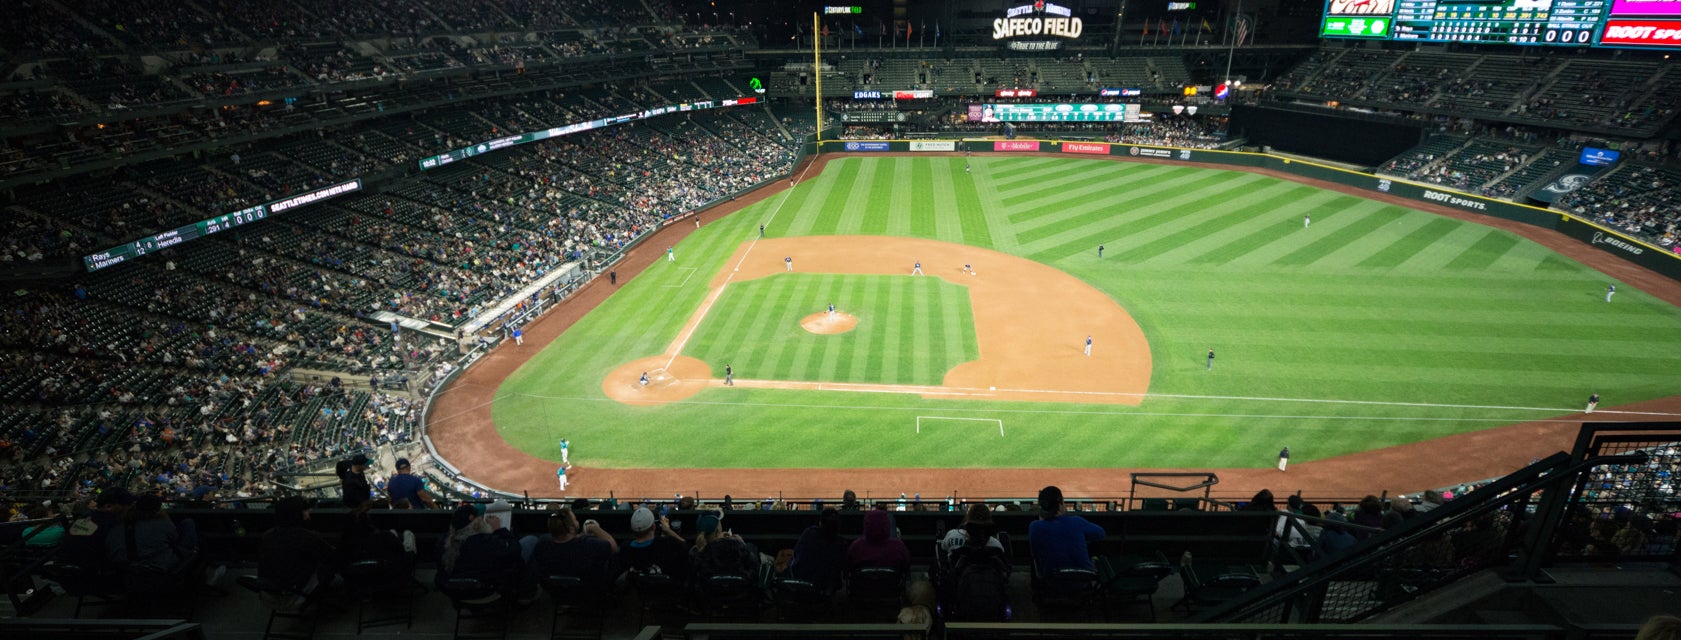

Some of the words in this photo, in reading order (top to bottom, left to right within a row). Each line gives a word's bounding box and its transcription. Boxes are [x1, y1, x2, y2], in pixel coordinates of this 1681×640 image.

[992, 18, 1042, 40] SAFECO
[1043, 17, 1083, 39] FIELD
[1605, 26, 1657, 39] ROOT
[1545, 30, 1556, 42] 0
[1561, 30, 1573, 43] 0
[1578, 30, 1590, 43] 0
[1045, 41, 1058, 50] BLUE
[1068, 144, 1079, 153] Fly
[1079, 144, 1103, 152] Emirates
[270, 191, 330, 213] SEATTLETIMES.COM
[328, 185, 343, 197] HITS
[1423, 190, 1452, 202] ROOT
[236, 215, 243, 224] 0
[246, 212, 253, 221] 0
[256, 210, 264, 218] 0
[156, 235, 183, 249] Heredia
[1604, 236, 1644, 255] BOEING
[92, 252, 111, 263] Rays
[94, 255, 125, 270] Mariners
[137, 247, 146, 256] 12
